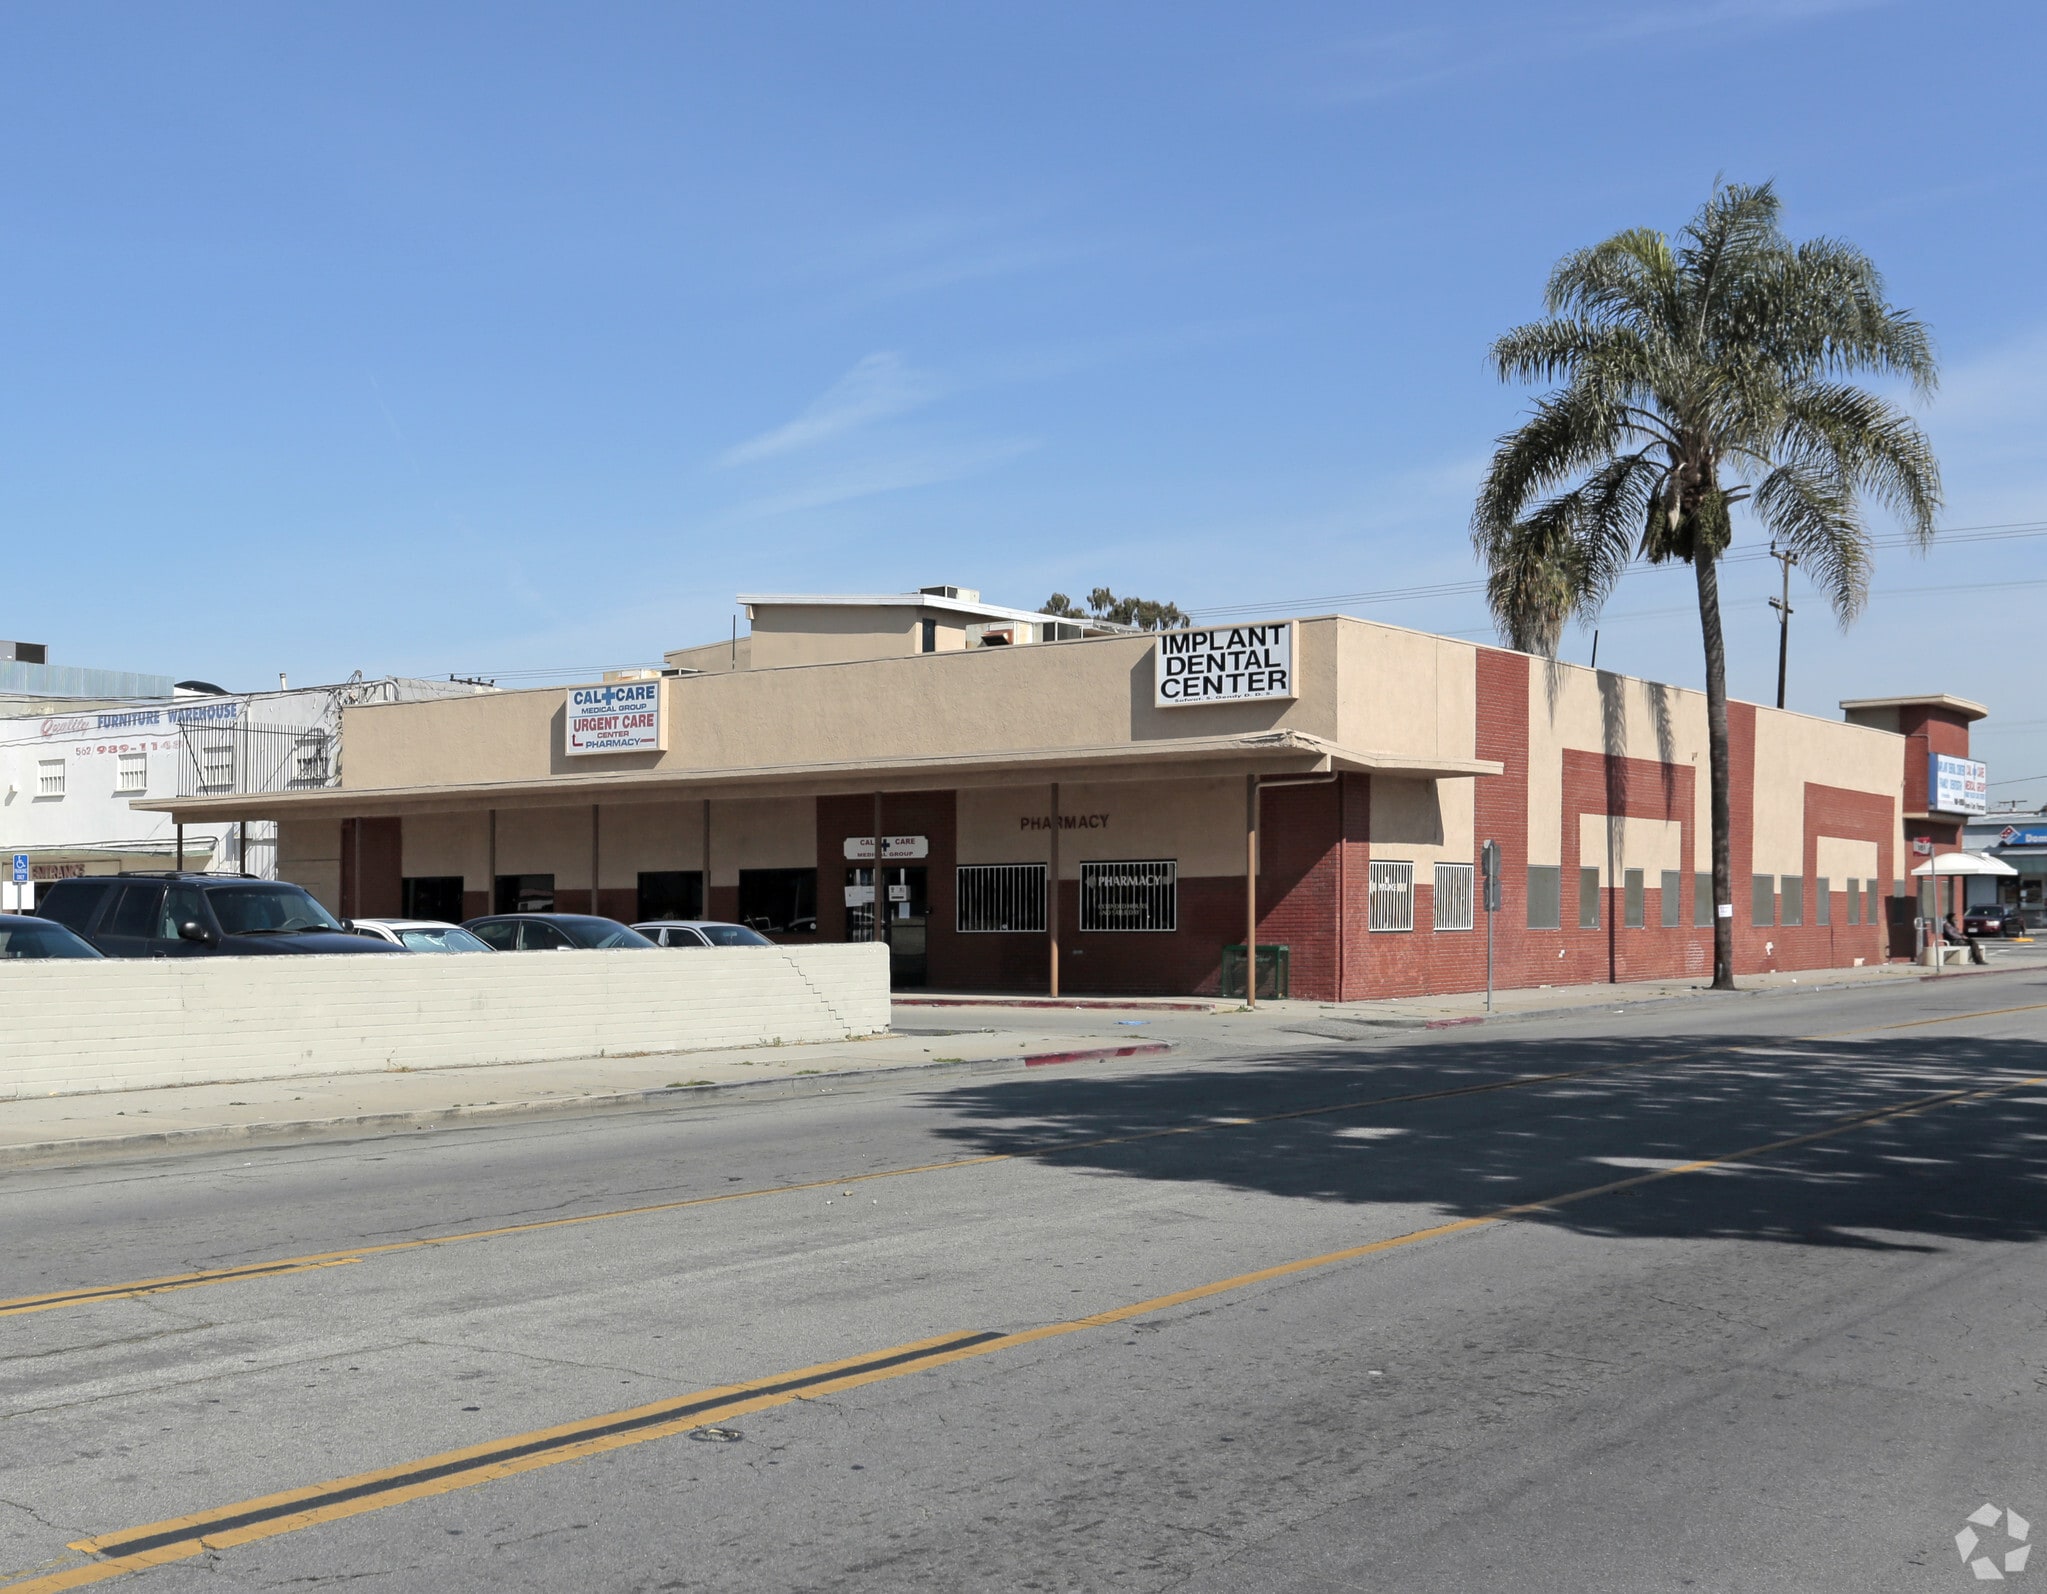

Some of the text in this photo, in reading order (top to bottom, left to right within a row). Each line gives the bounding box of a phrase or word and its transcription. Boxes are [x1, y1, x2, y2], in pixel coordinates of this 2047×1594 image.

[1162, 624, 1286, 655] IMPLANT
[1166, 648, 1281, 676] DENTAL
[1160, 669, 1287, 699] CENTER
[574, 686, 655, 705] CAL CARE
[97, 710, 160, 729] FURNITURE
[168, 703, 237, 723] WAREHOUSE
[573, 713, 654, 732] URGENT CARE
[586, 738, 640, 748] PHARMACY
[894, 837, 916, 845] CARE
[1098, 874, 1162, 887] PHARMACY
